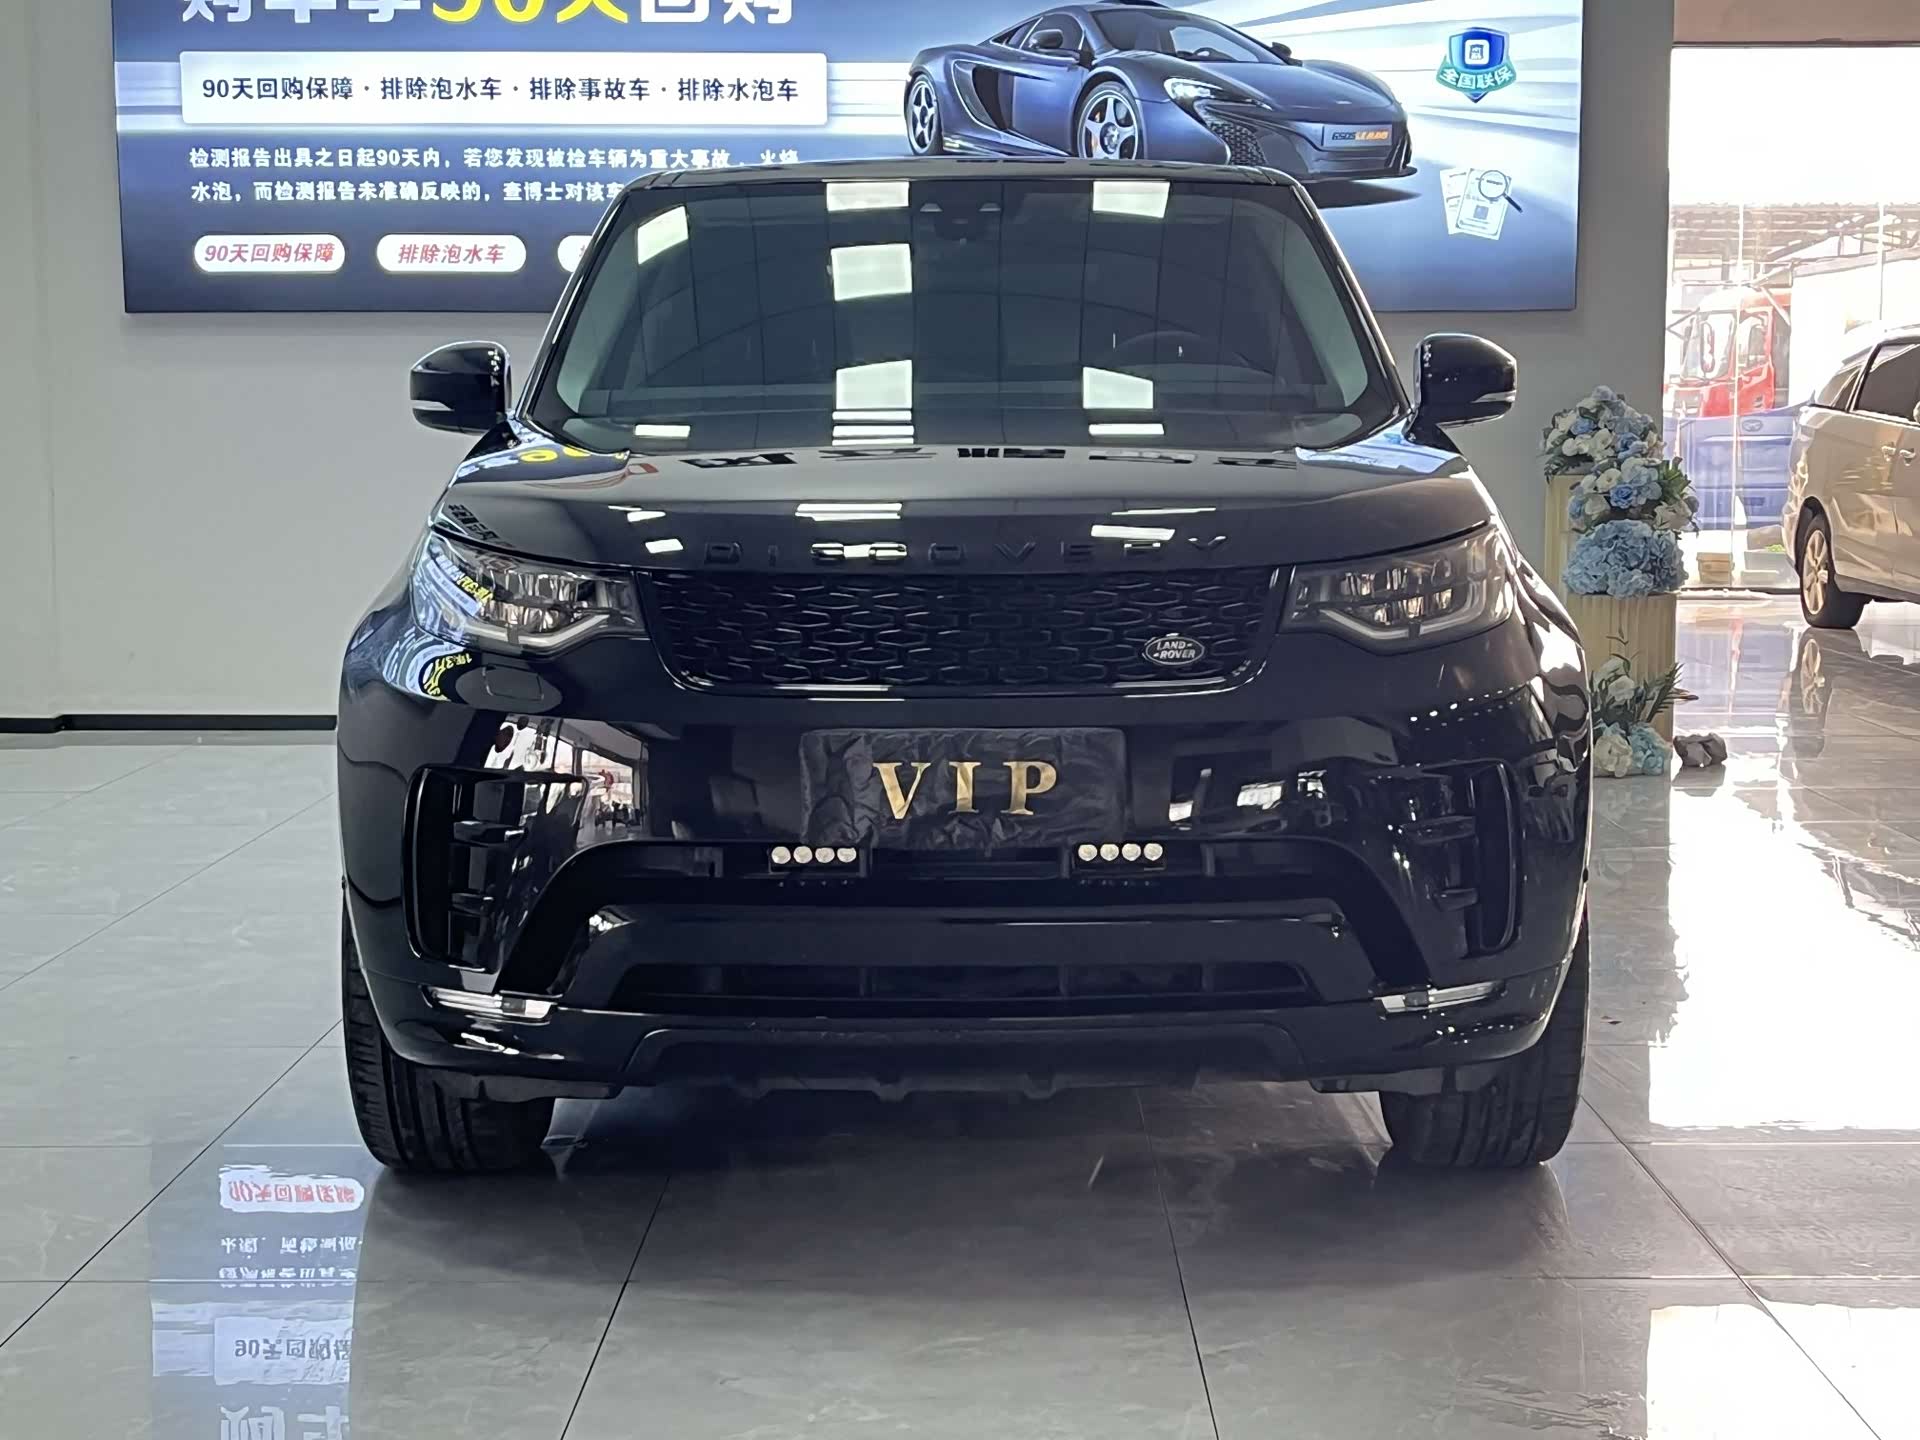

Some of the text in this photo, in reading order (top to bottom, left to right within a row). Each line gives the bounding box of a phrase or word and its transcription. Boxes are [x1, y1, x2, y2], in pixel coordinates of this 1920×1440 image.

[202, 76, 799, 101] 90天回购保障 排除泡水车 排除事故车 排除水泡车
[1440, 66, 1514, 90] 全国联保
[204, 242, 336, 263] 90天回购保障
[397, 243, 506, 265] 排除泡水车
[704, 536, 1228, 565] DISCOVERY
[872, 761, 1058, 820] VIP
